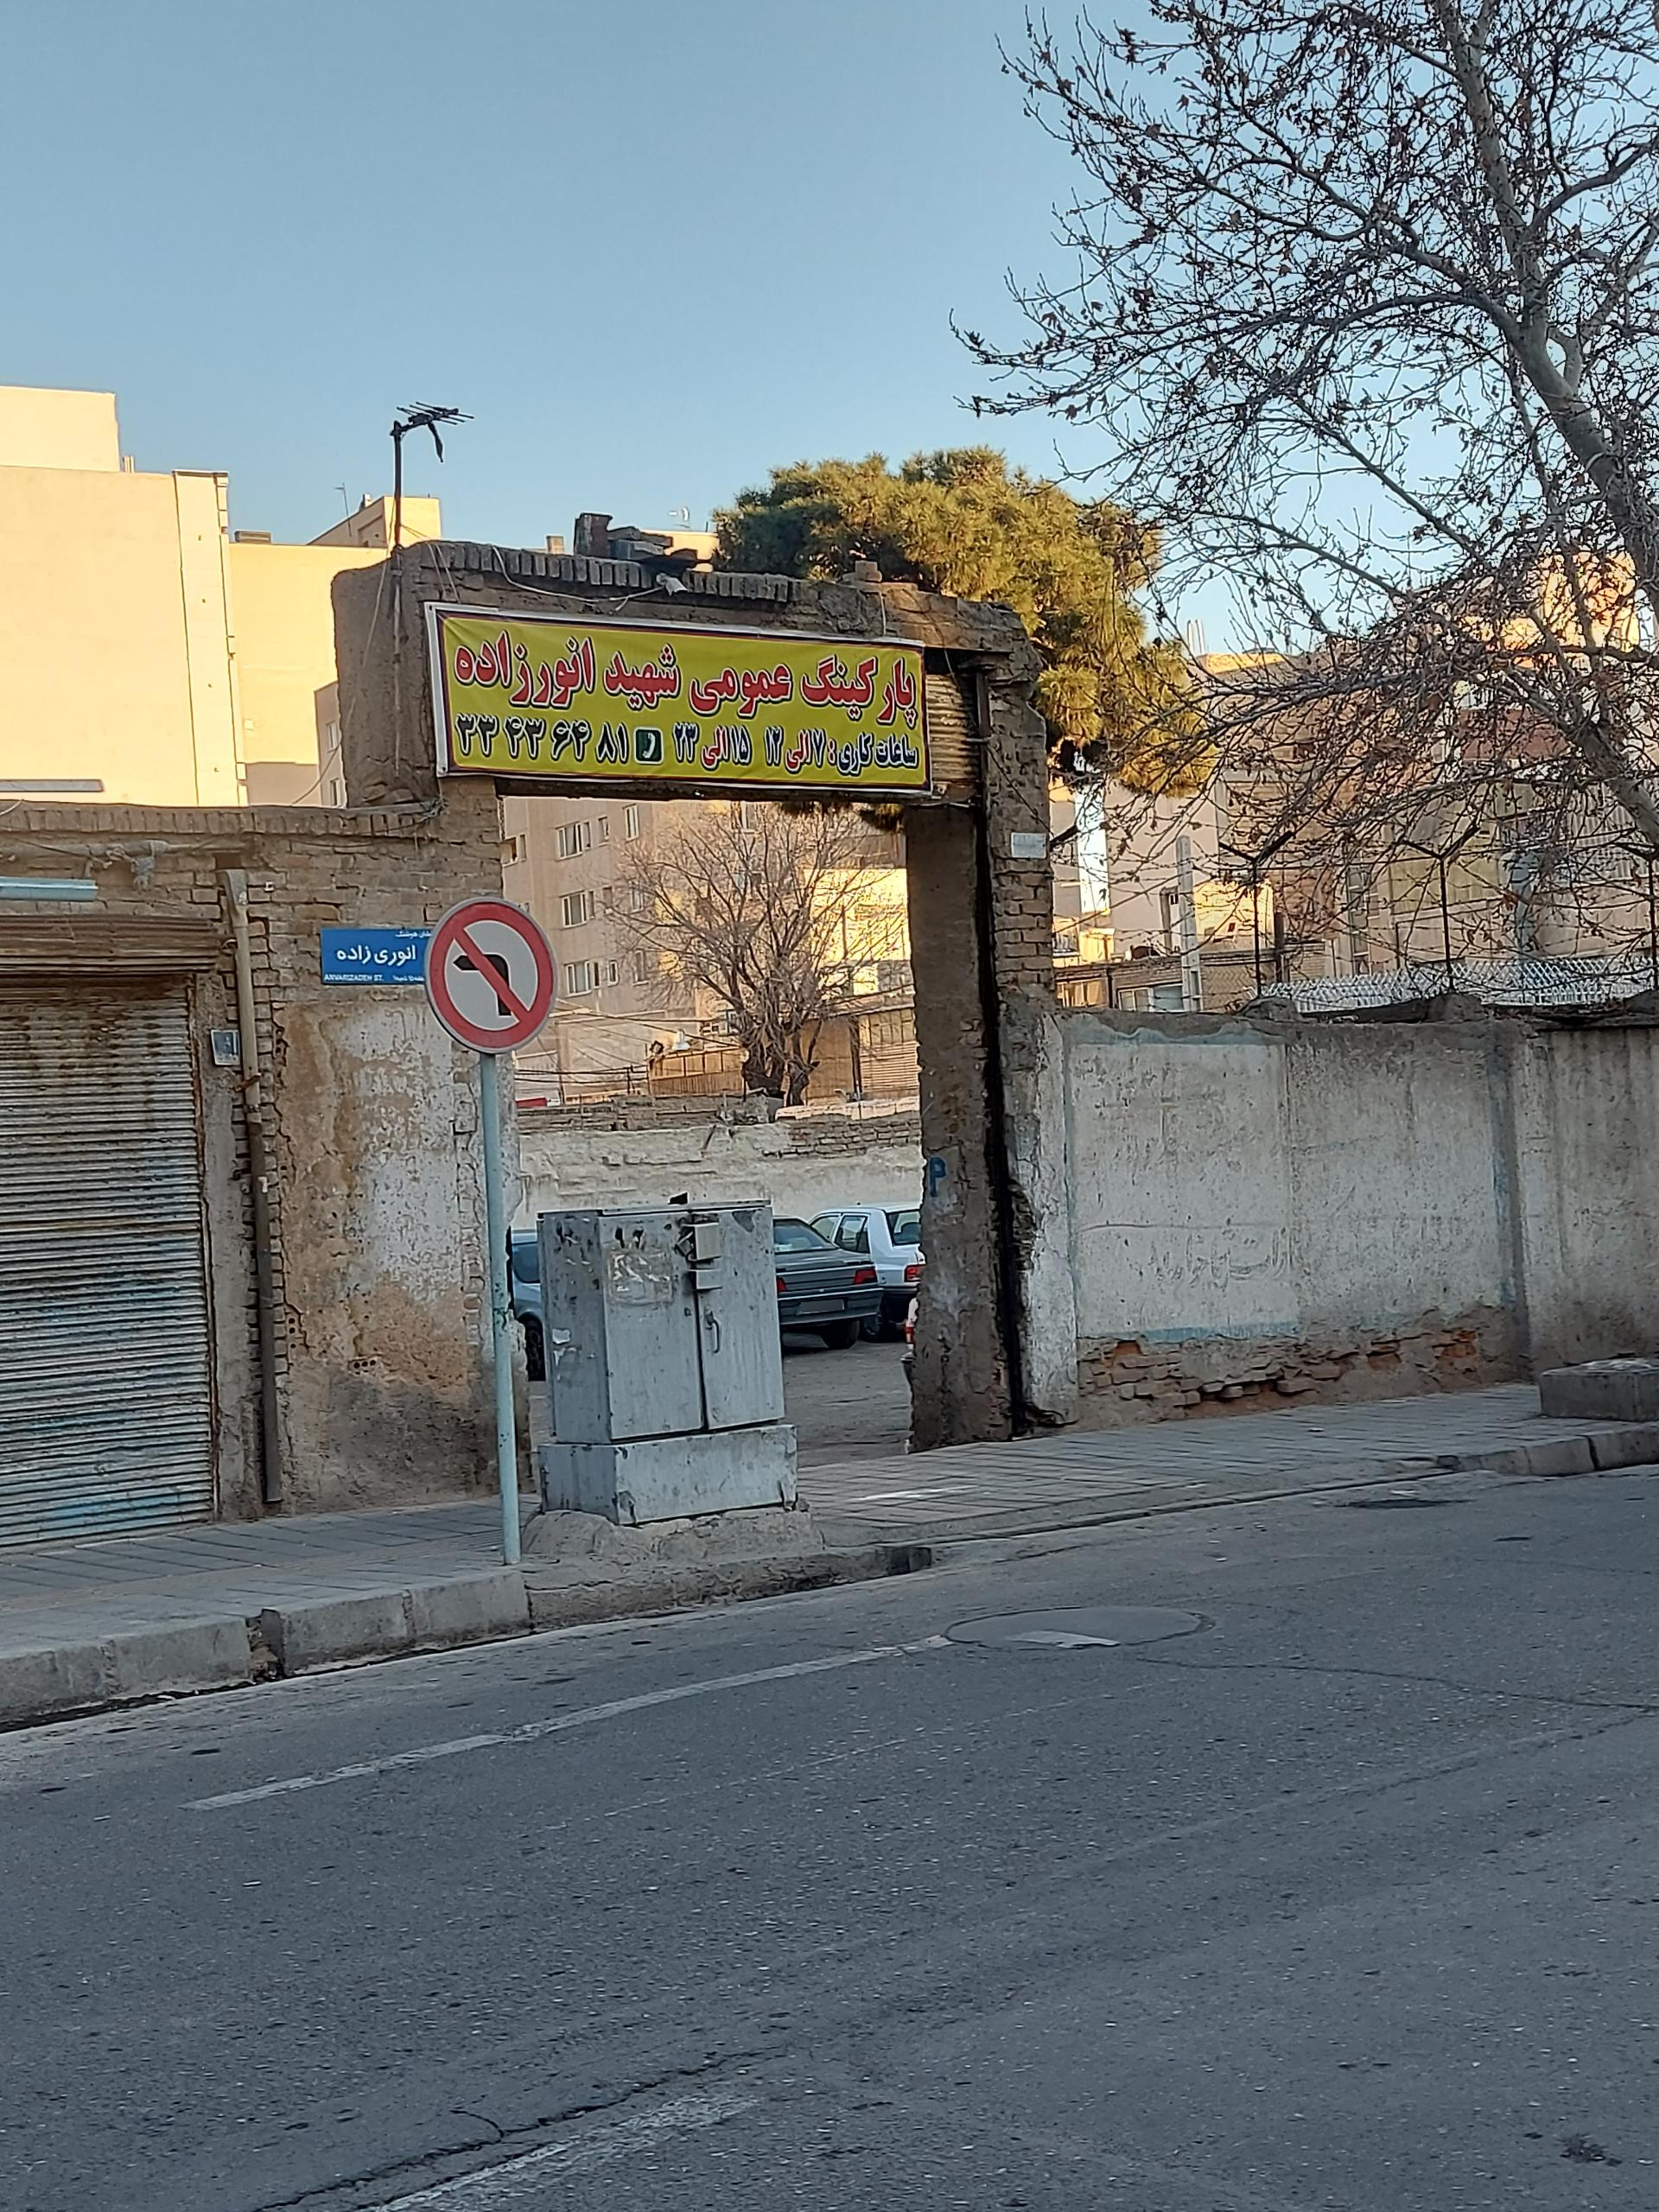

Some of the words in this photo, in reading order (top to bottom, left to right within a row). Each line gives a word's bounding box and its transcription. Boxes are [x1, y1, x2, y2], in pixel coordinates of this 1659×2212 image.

[454, 630, 596, 709] انورزاده
[603, 643, 683, 713] شهید
[689, 664, 792, 717] عمومی
[801, 655, 918, 727] پارکینگ
[701, 725, 730, 770] الی
[784, 728, 811, 772] الی
[874, 734, 918, 768] ساعات
[336, 944, 372, 964] زاده
[374, 944, 417, 967] انوری
[929, 1156, 947, 1198] P
